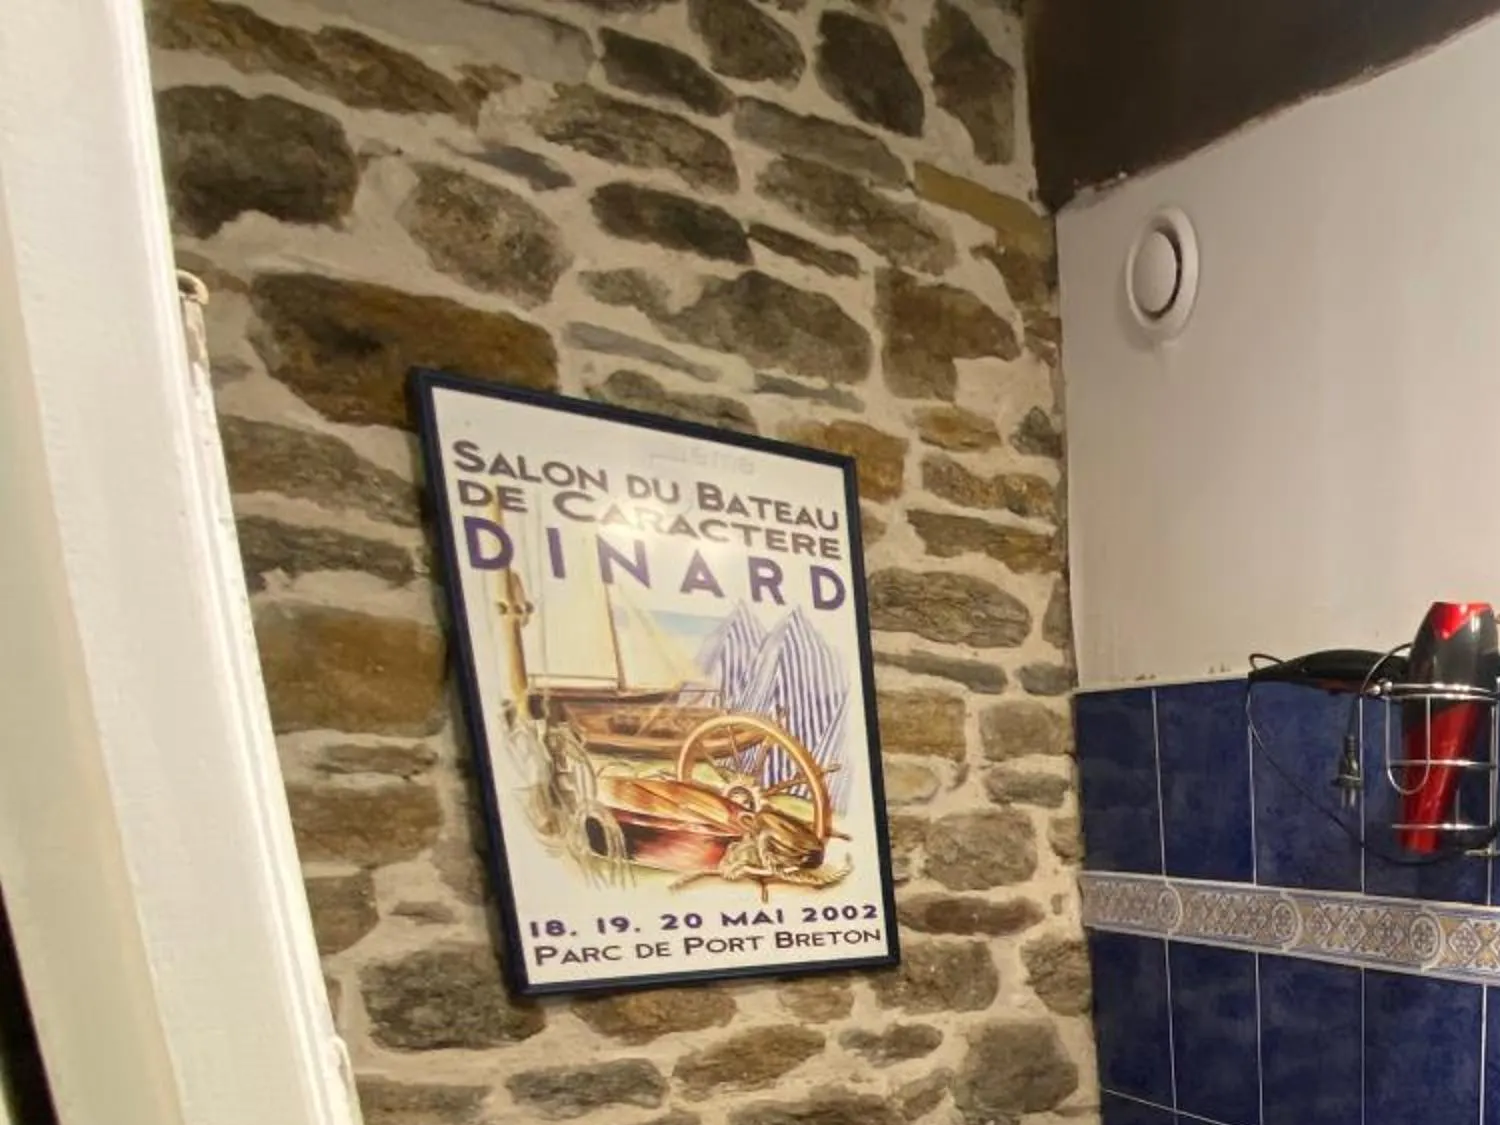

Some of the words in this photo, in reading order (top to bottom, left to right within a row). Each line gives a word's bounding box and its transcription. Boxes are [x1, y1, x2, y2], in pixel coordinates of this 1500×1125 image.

[453, 439, 607, 494] SALON
[627, 474, 680, 504] DU
[696, 480, 840, 532] BATEAU
[457, 479, 528, 513] DE
[464, 516, 847, 612] DINARD
[530, 920, 577, 938] 18.
[598, 915, 641, 935] 19.
[661, 912, 703, 931] 20
[721, 907, 784, 927] MAI
[802, 904, 879, 923] 2002
[535, 944, 622, 967] PARC
[636, 942, 672, 959] DE
[684, 934, 766, 956] PORT
[775, 928, 881, 950] BRETON
